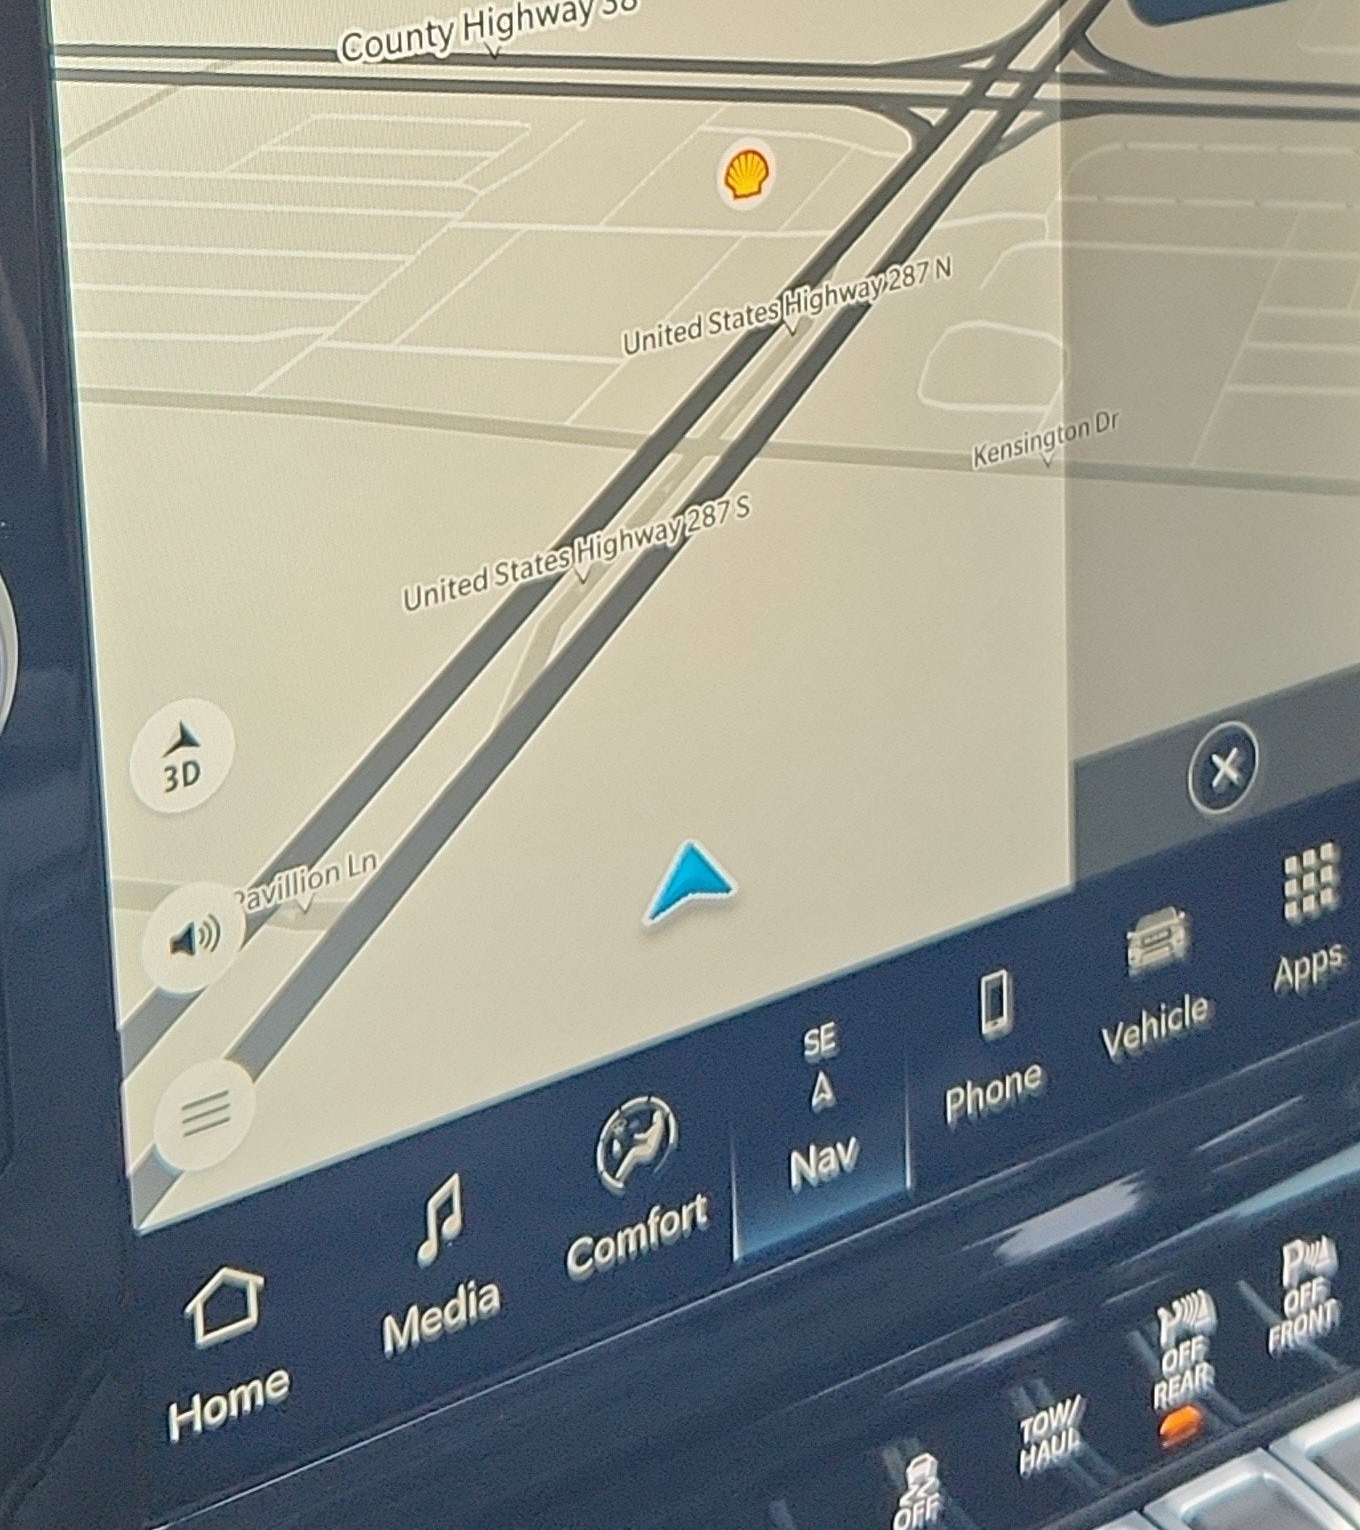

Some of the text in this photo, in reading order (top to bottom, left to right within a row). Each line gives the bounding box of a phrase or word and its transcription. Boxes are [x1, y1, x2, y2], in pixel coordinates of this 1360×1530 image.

[341, 18, 454, 64] County
[622, 256, 952, 359] United States Highway 287 N
[973, 410, 1120, 470] Kensington Dr
[403, 494, 752, 614] United States Highway 287 S
[163, 760, 202, 795] 3D
[347, 851, 378, 879] Ln
[1272, 941, 1344, 994] Apps
[804, 1020, 837, 1060] SE
[1102, 993, 1210, 1063] Vehicle
[945, 1062, 1043, 1128] Phone
[789, 1136, 859, 1192] Nav
[566, 1192, 709, 1281] Comfort
[383, 1280, 501, 1359] Media
[1283, 1275, 1330, 1319] OFF
[1267, 1297, 1339, 1358] FRONT
[1161, 1334, 1209, 1379] OFF
[168, 1369, 292, 1444] Home
[1153, 1362, 1215, 1413] REAR
[1020, 1393, 1087, 1445] TOW/
[1019, 1426, 1082, 1478] HAUL
[892, 1492, 942, 1530] OFF
